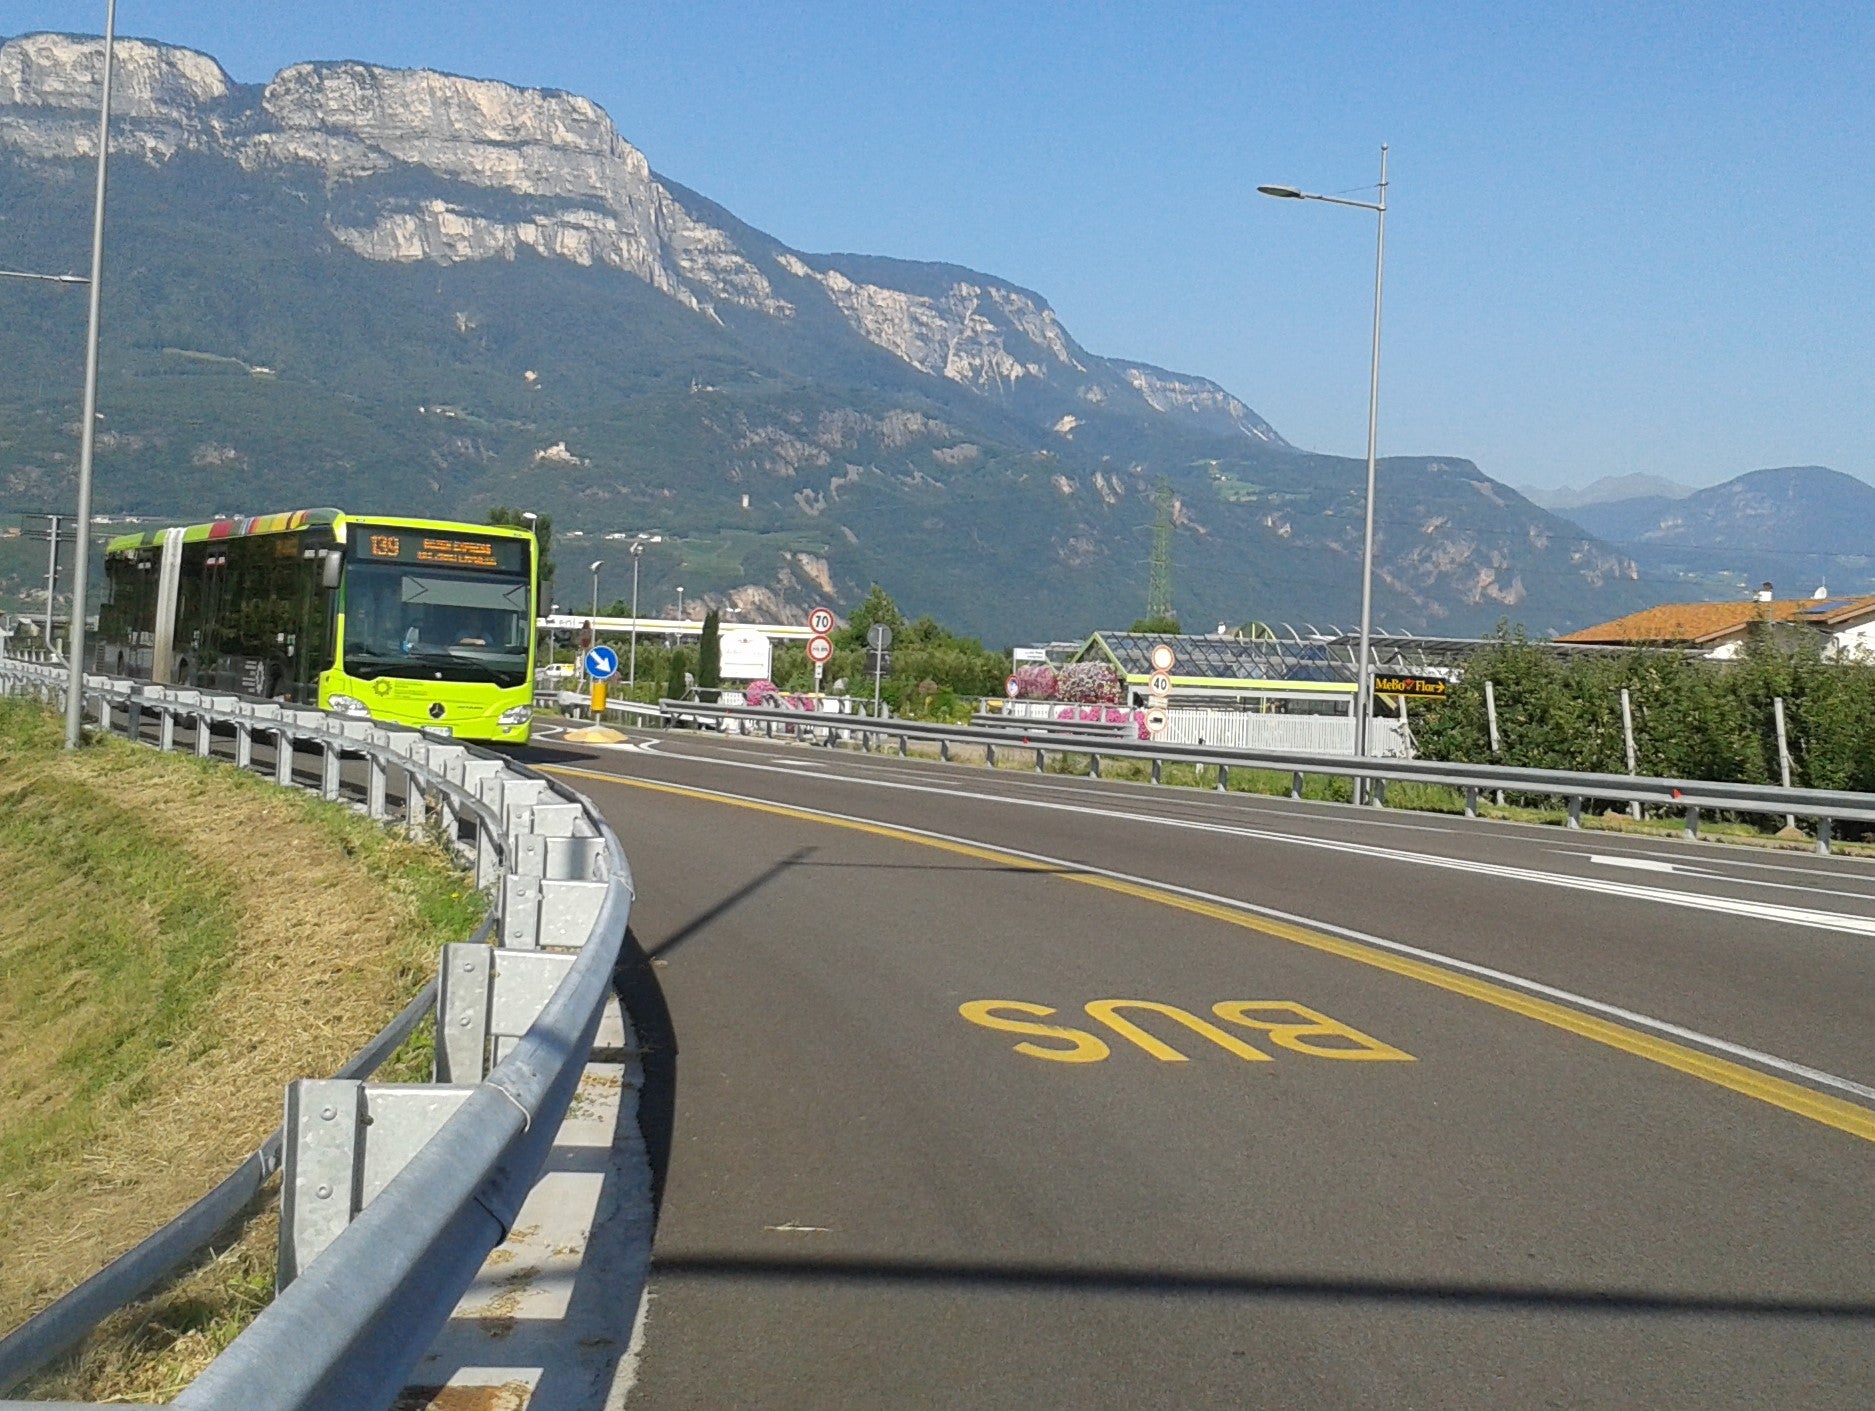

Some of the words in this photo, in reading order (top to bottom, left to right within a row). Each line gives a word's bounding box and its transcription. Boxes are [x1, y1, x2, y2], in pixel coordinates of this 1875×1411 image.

[815, 615, 828, 627] 70
[1154, 677, 1167, 690] 40
[1375, 678, 1405, 691] MeBo
[1415, 680, 1435, 692] Flor
[959, 999, 1418, 1063] BUS
